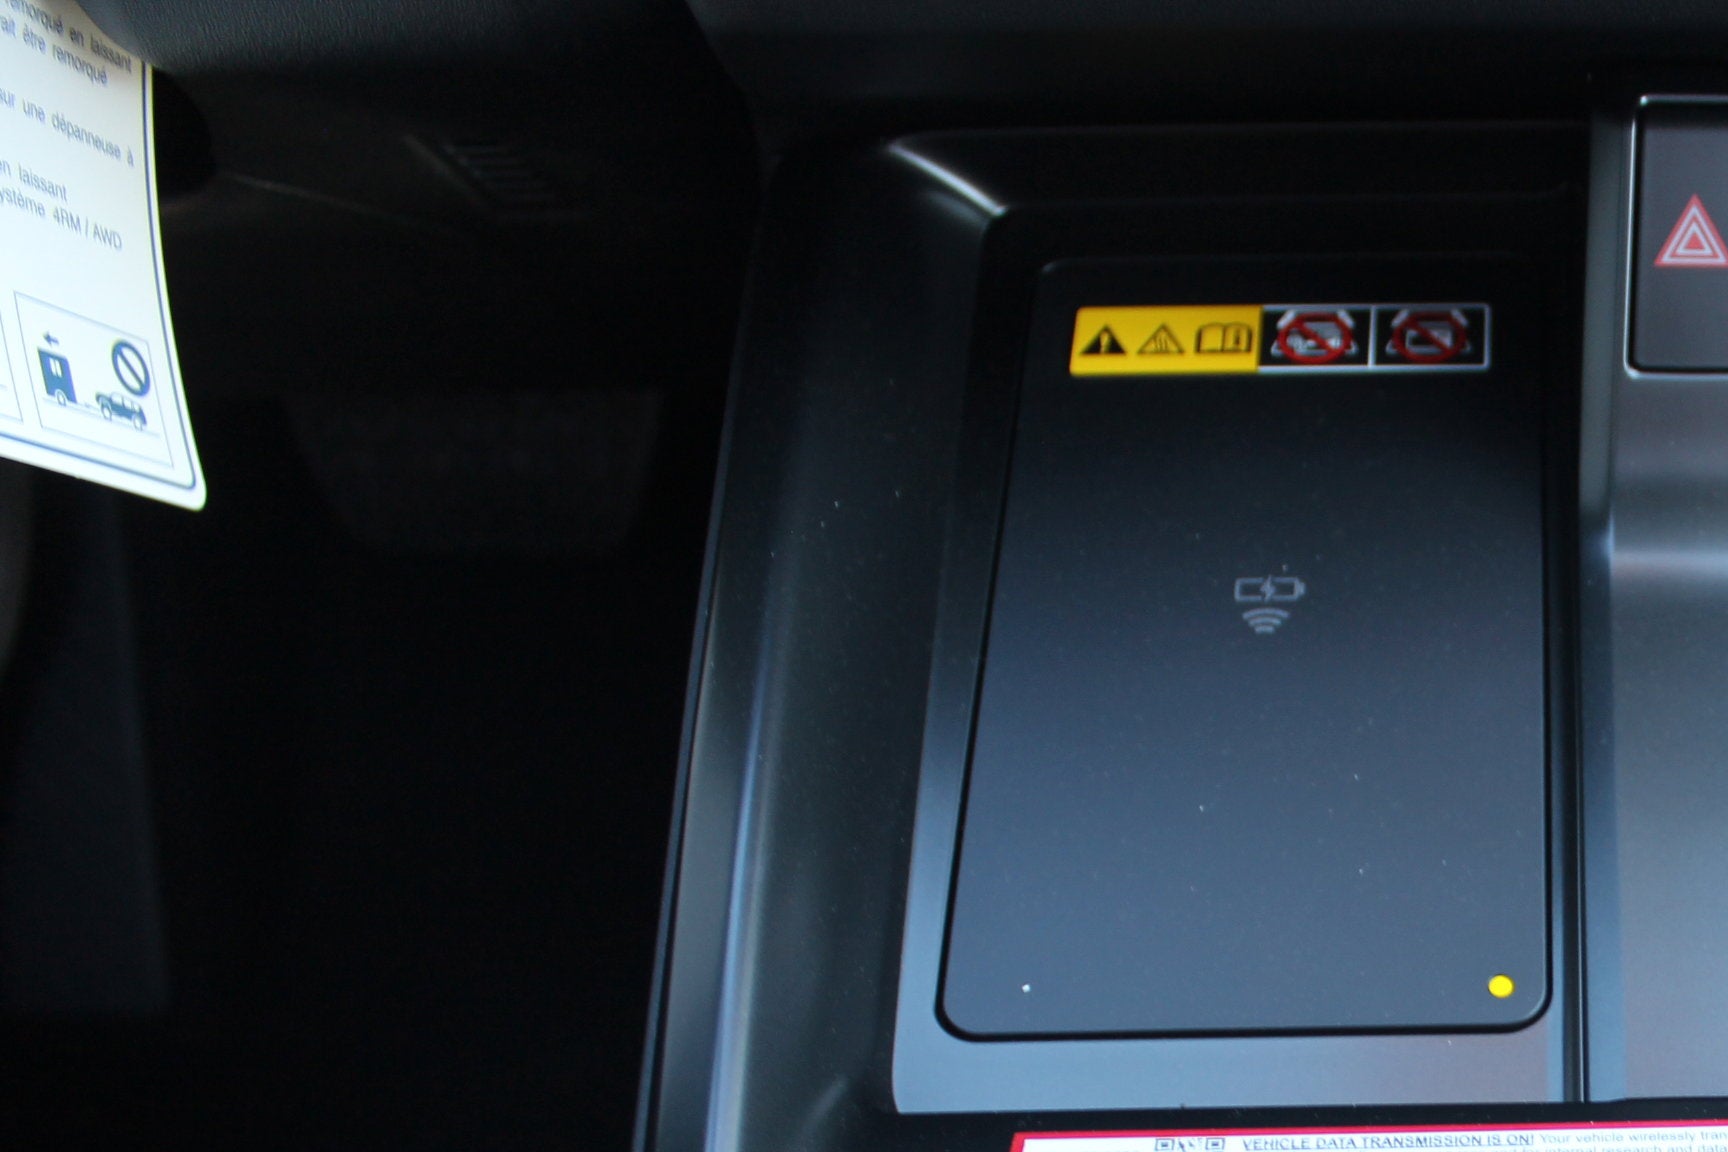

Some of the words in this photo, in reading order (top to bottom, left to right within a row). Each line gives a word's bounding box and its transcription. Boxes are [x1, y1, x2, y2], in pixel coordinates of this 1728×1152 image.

[52, 44, 108, 86] remorqué
[22, 98, 46, 124] une
[18, 162, 67, 203] laissant
[93, 222, 122, 250] AWD
[1241, 1138, 1310, 1150] VEHICLE
[1315, 1137, 1357, 1149] DATA
[1361, 1133, 1482, 1149] TRANSMISSION
[1487, 1134, 1501, 1147] IS
[1506, 1133, 1534, 1146] ON!
[1540, 1133, 1571, 1144] Your
[1576, 1131, 1624, 1143] vehicle
[1629, 1130, 1695, 1143] wirelessly
